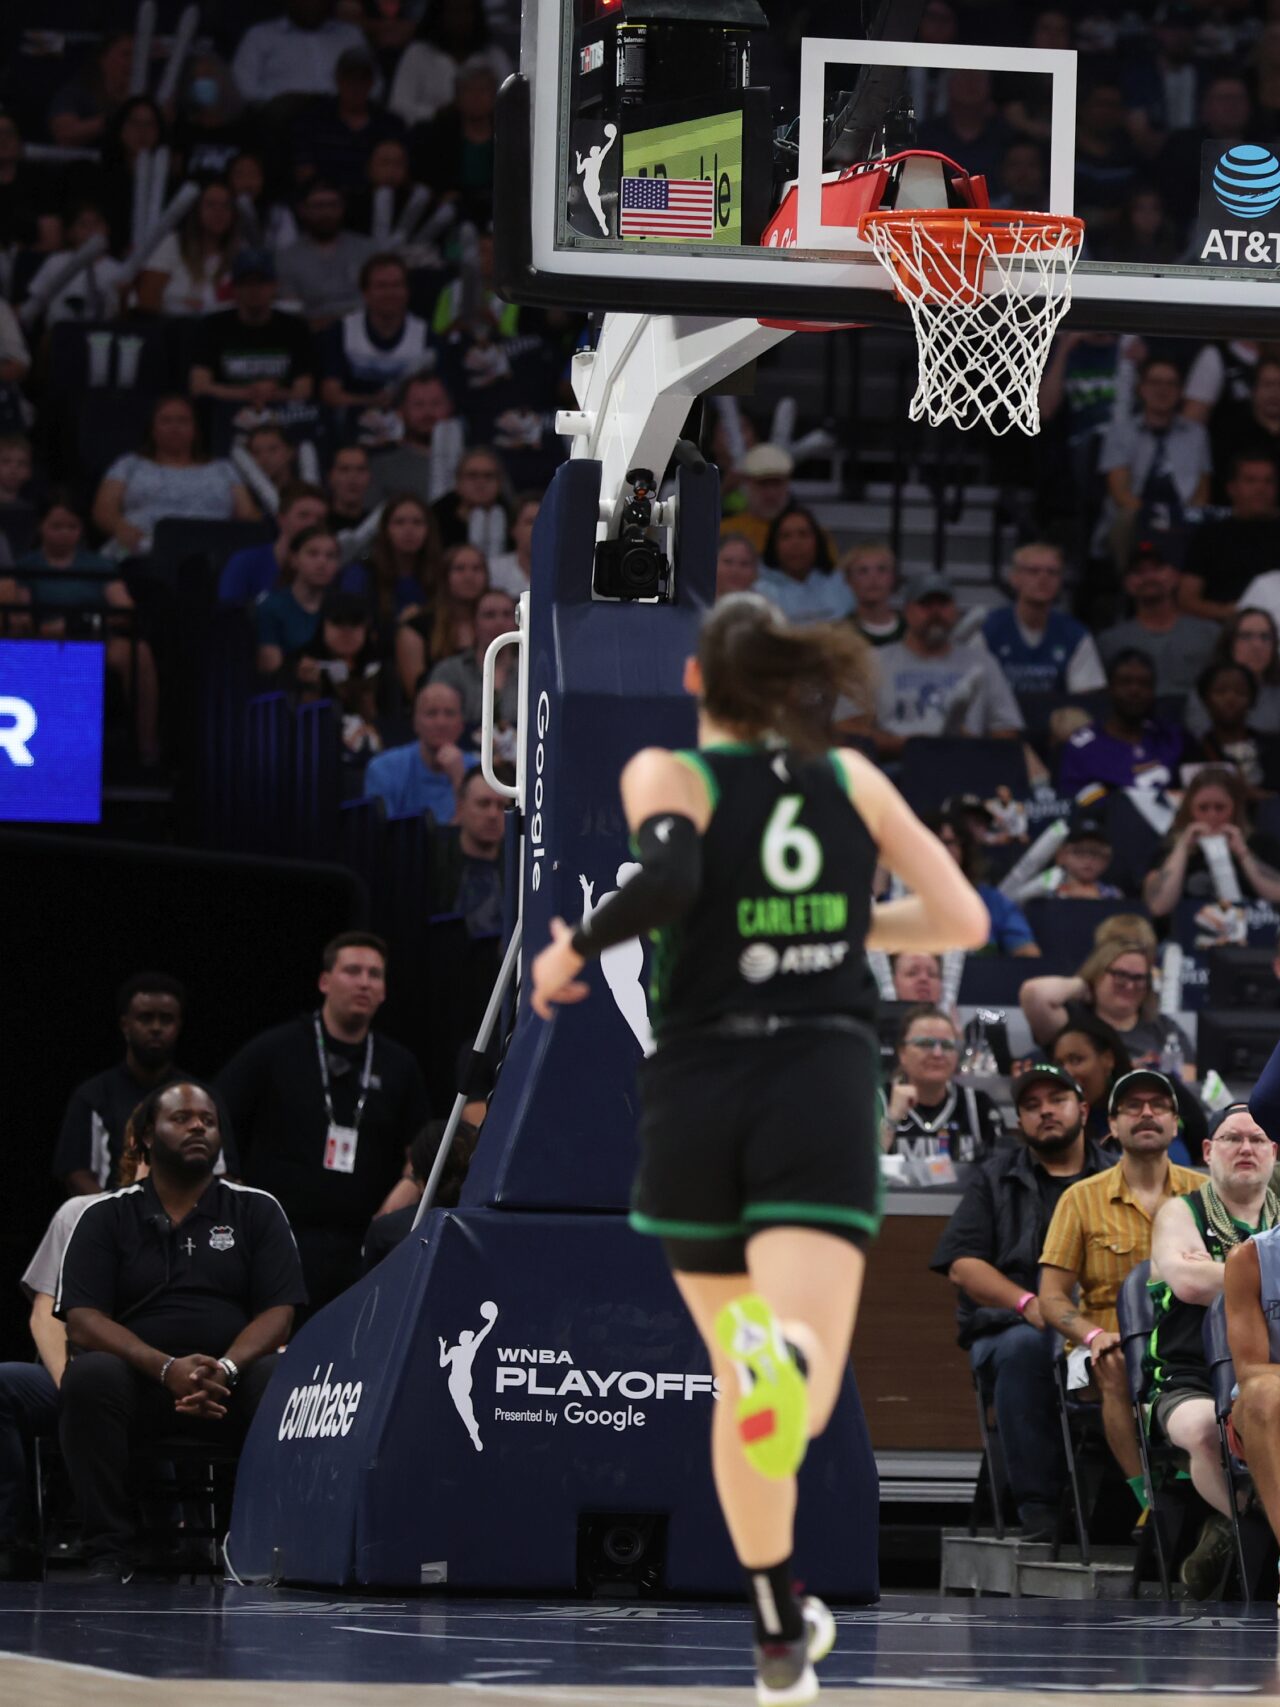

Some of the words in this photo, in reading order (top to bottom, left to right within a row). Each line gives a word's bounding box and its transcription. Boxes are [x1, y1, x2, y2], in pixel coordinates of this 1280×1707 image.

[532, 690, 550, 891] Google
[761, 794, 824, 893] 6
[737, 892, 848, 937] CARLETON
[497, 1347, 574, 1365] WNBA
[278, 1362, 363, 1441] coinbase
[495, 1407, 543, 1423] Presented
[545, 1409, 558, 1426] by
[563, 1401, 646, 1431] Google
